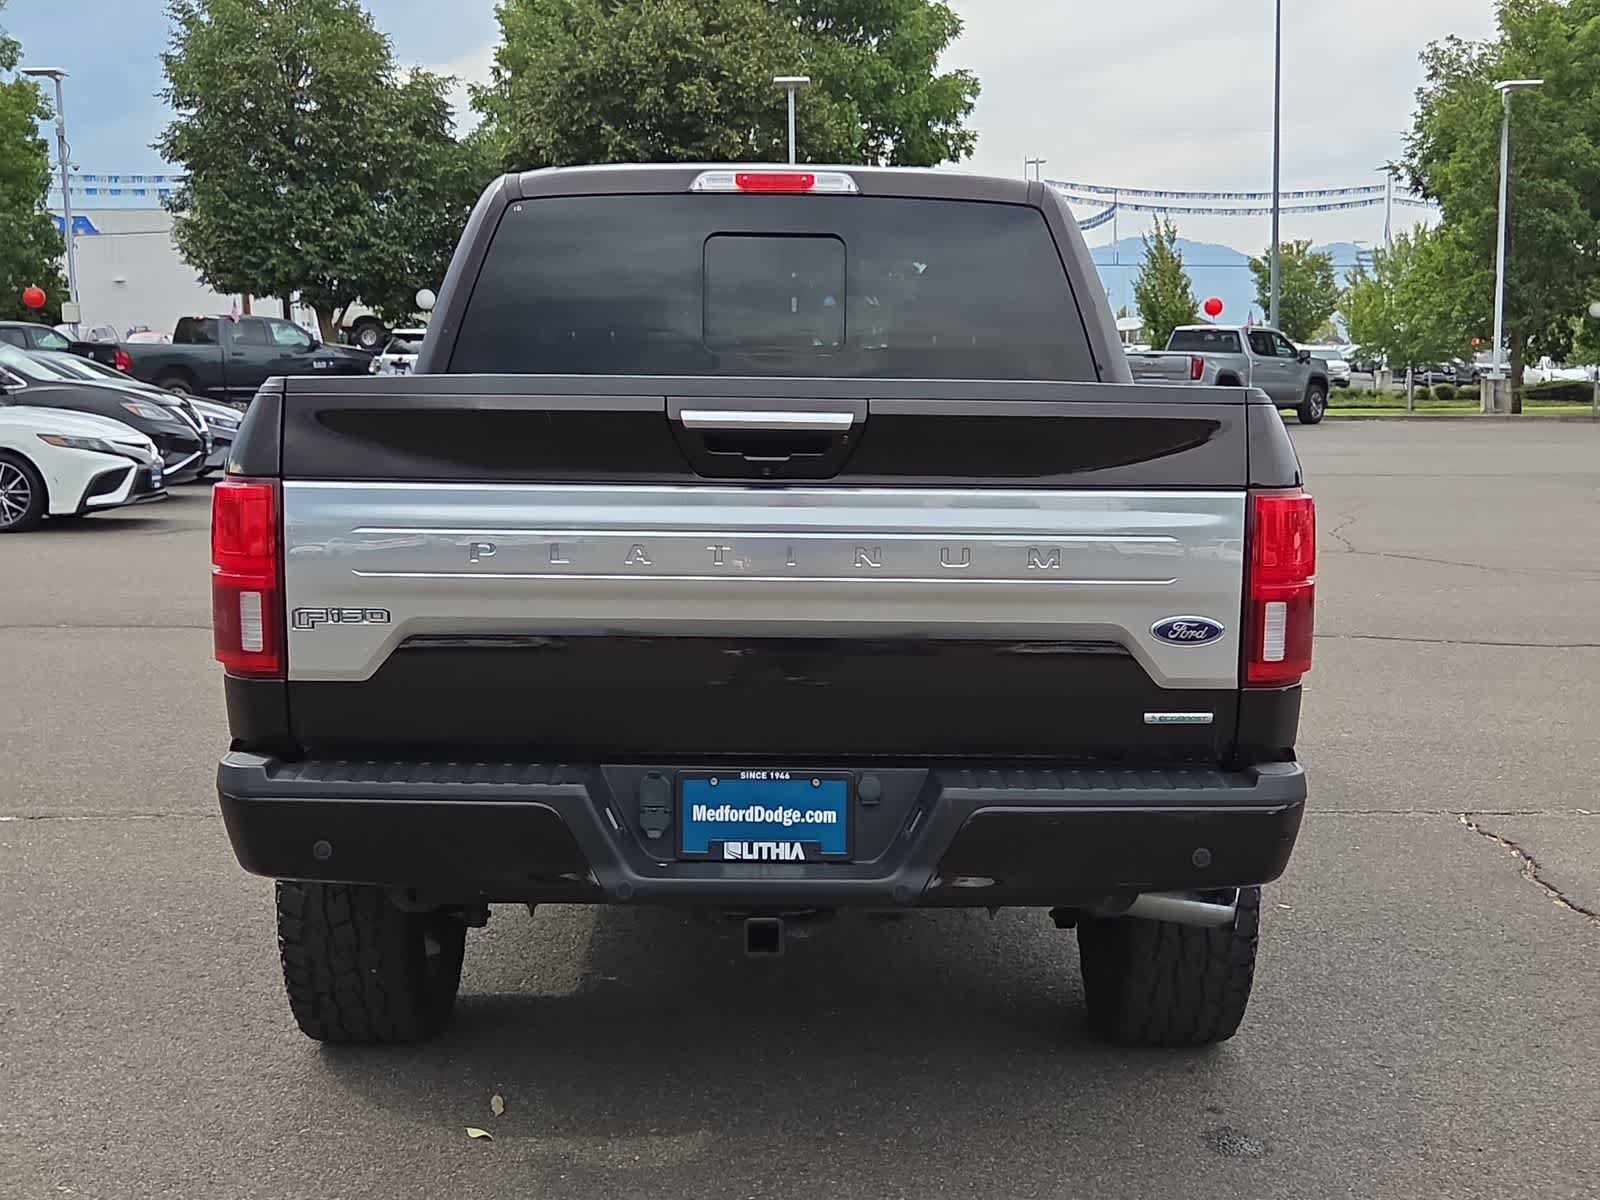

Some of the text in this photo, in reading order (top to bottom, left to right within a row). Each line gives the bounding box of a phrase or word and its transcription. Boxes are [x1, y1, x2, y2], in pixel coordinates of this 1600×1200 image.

[470, 542, 1061, 570] PLATINUM
[1167, 622, 1209, 640] Ford
[740, 771, 790, 780] SINCE 1946
[692, 805, 837, 826] MedfordDodge.com
[742, 842, 805, 860] LITHIA
